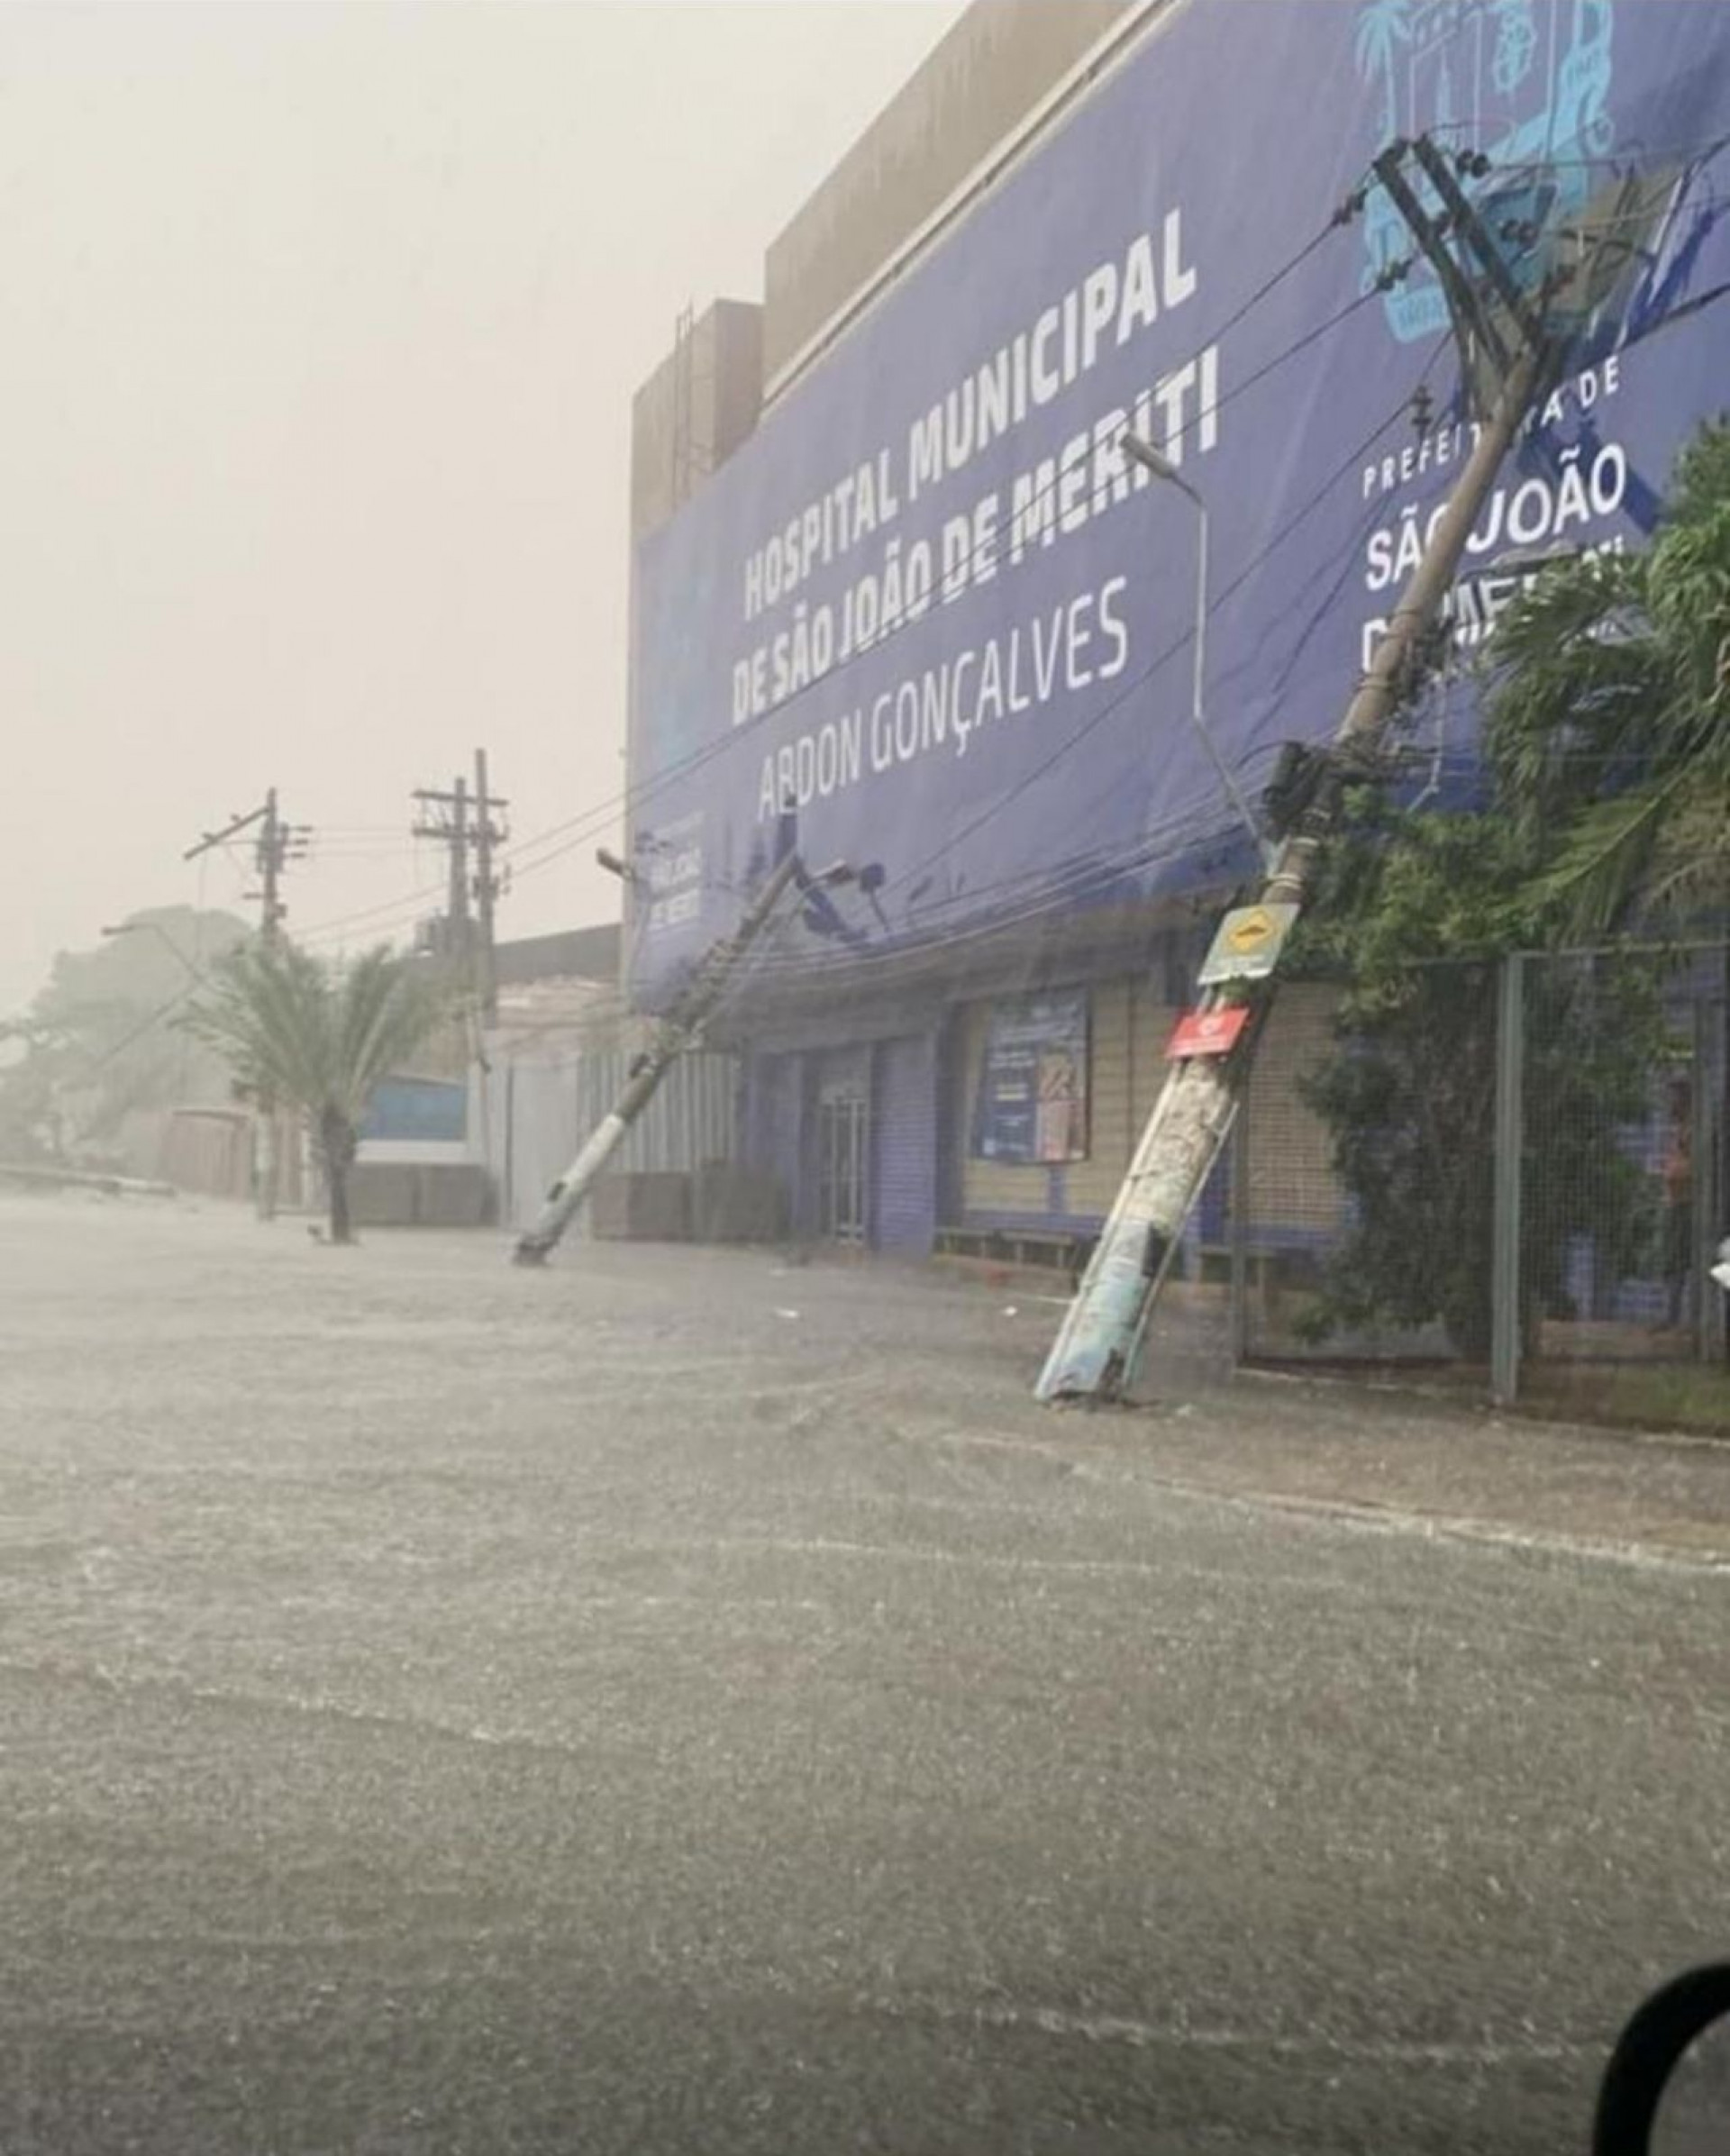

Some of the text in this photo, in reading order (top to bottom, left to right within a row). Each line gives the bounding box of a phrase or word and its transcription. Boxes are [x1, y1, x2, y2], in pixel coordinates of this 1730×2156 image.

[742, 208, 1198, 621] HOSPITAL MUNICIPAL
[1465, 442, 1625, 553] JOÃO
[1580, 356, 1619, 408] DE
[732, 345, 1219, 724] DE SÃO JOÃO DE MERITI
[758, 577, 1128, 822] ABDON GONÇALVES
